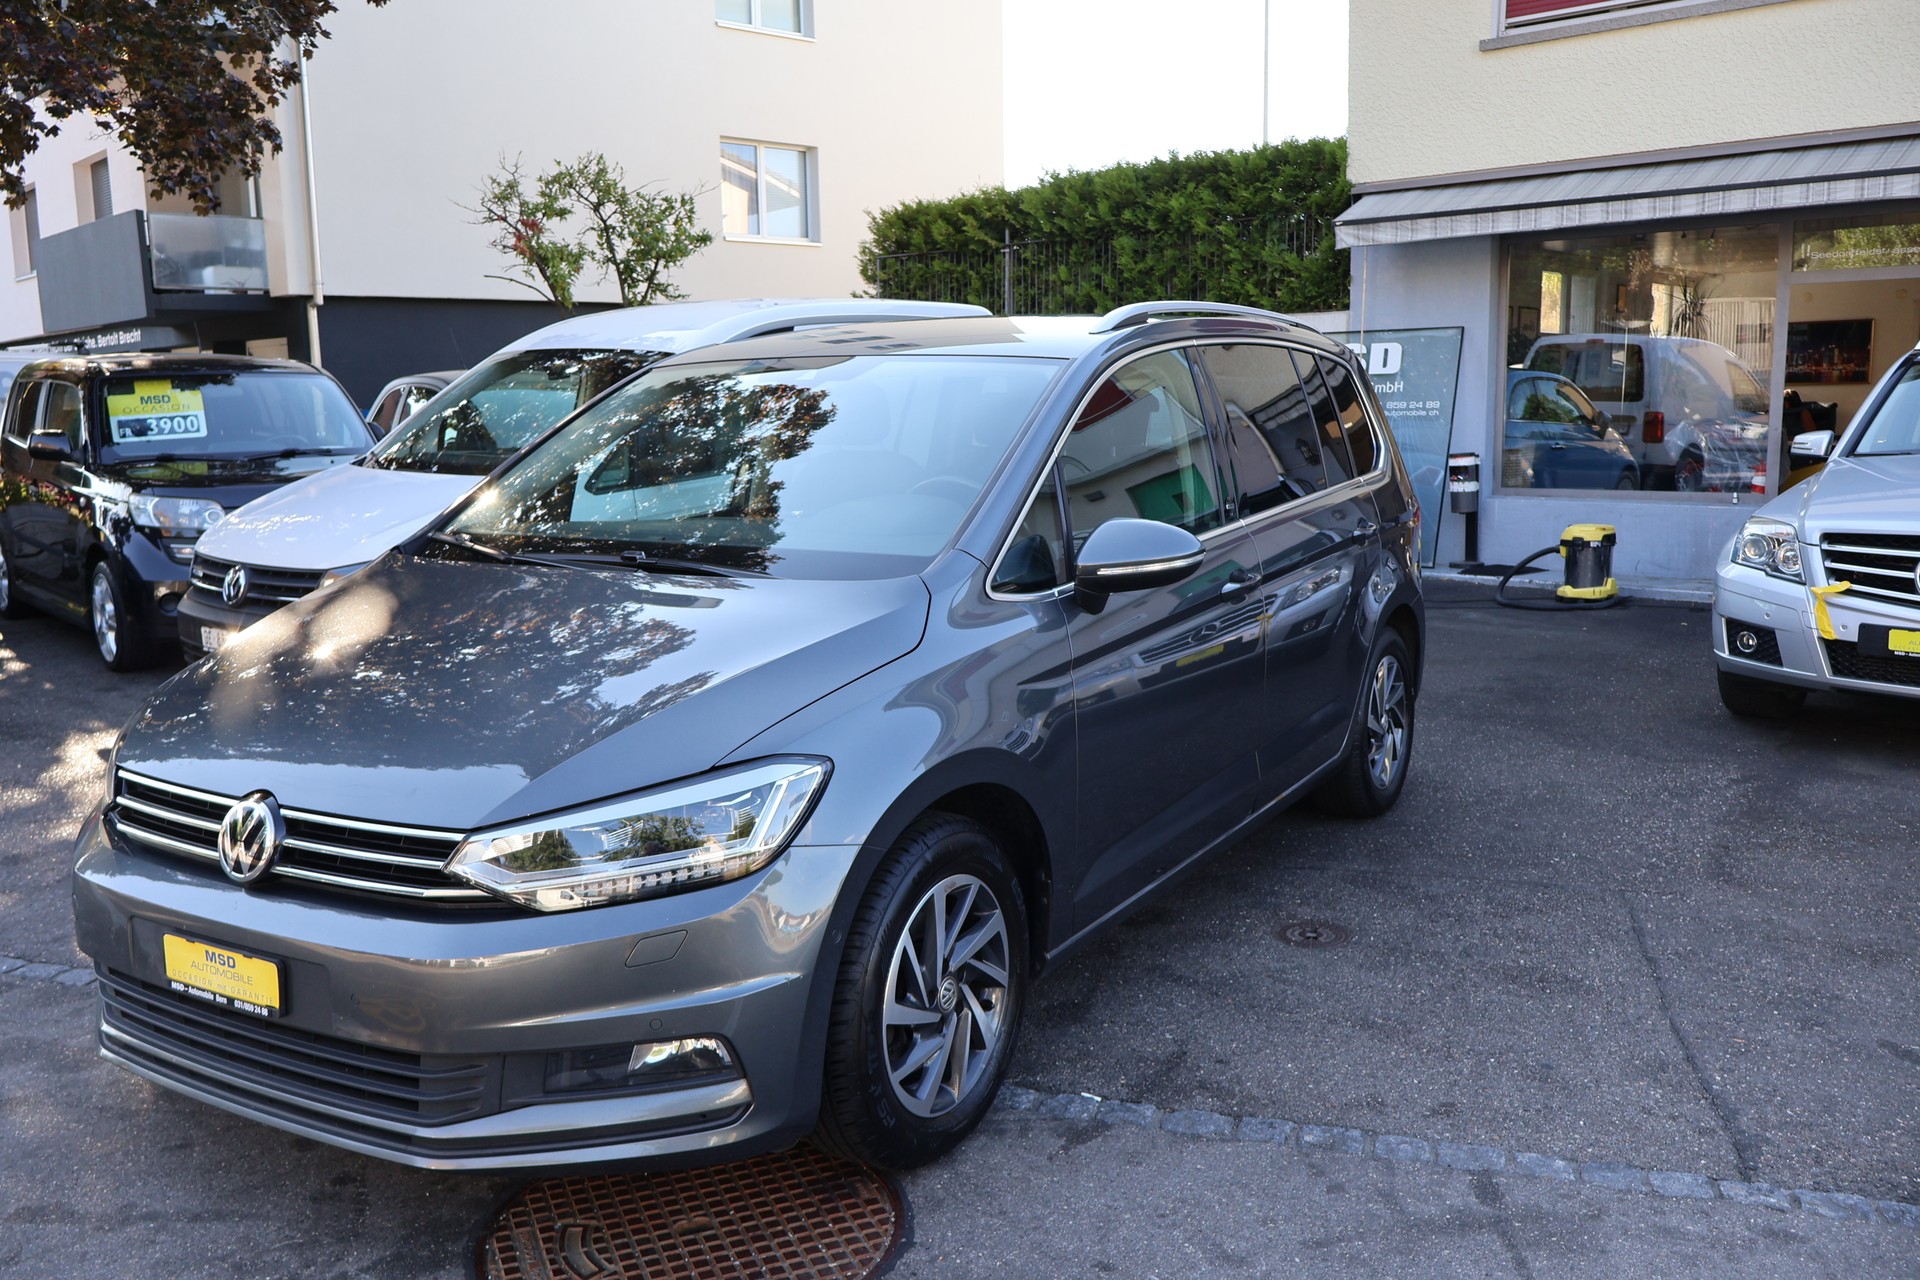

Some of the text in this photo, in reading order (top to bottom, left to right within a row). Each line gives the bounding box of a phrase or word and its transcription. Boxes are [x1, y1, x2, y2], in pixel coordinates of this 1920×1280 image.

[97, 332, 118, 347] Bertolt
[119, 328, 141, 345] Brecht
[1371, 381, 1404, 393] mbH
[123, 403, 190, 414] OCCASION
[140, 395, 171, 405] MSD
[1386, 401, 1406, 409] 859
[1409, 401, 1423, 409] 24
[147, 416, 198, 435] 3900
[205, 949, 236, 969] MSD
[190, 960, 254, 985] AUTOMOBILE
[172, 968, 213, 988] OCCASION
[231, 986, 274, 1004] GARANTIE
[215, 994, 228, 1005] Bern
[254, 1004, 261, 1014] 24
